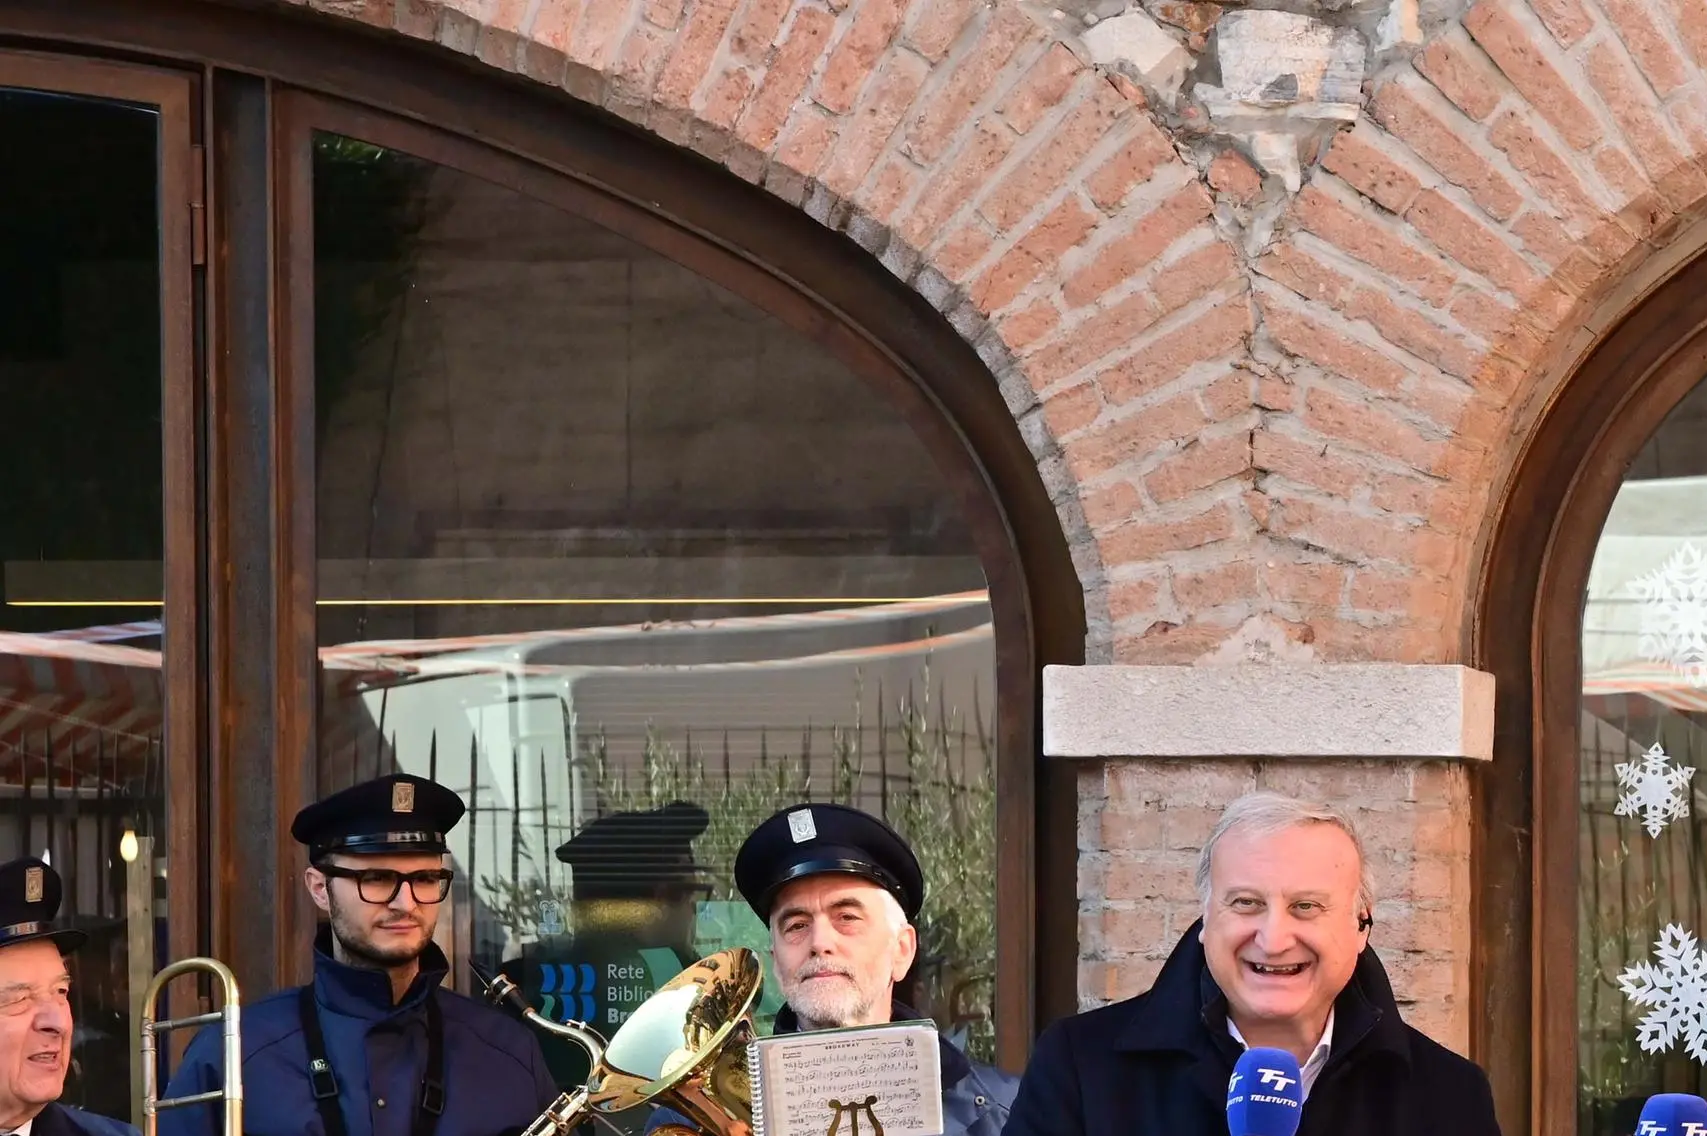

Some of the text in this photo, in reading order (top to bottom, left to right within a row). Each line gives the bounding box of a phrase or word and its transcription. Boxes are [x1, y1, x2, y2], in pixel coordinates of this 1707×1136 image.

[607, 964, 645, 979] Rete
[607, 985, 653, 1002] Biblio
[1250, 1094, 1298, 1108] TELETUTTO
